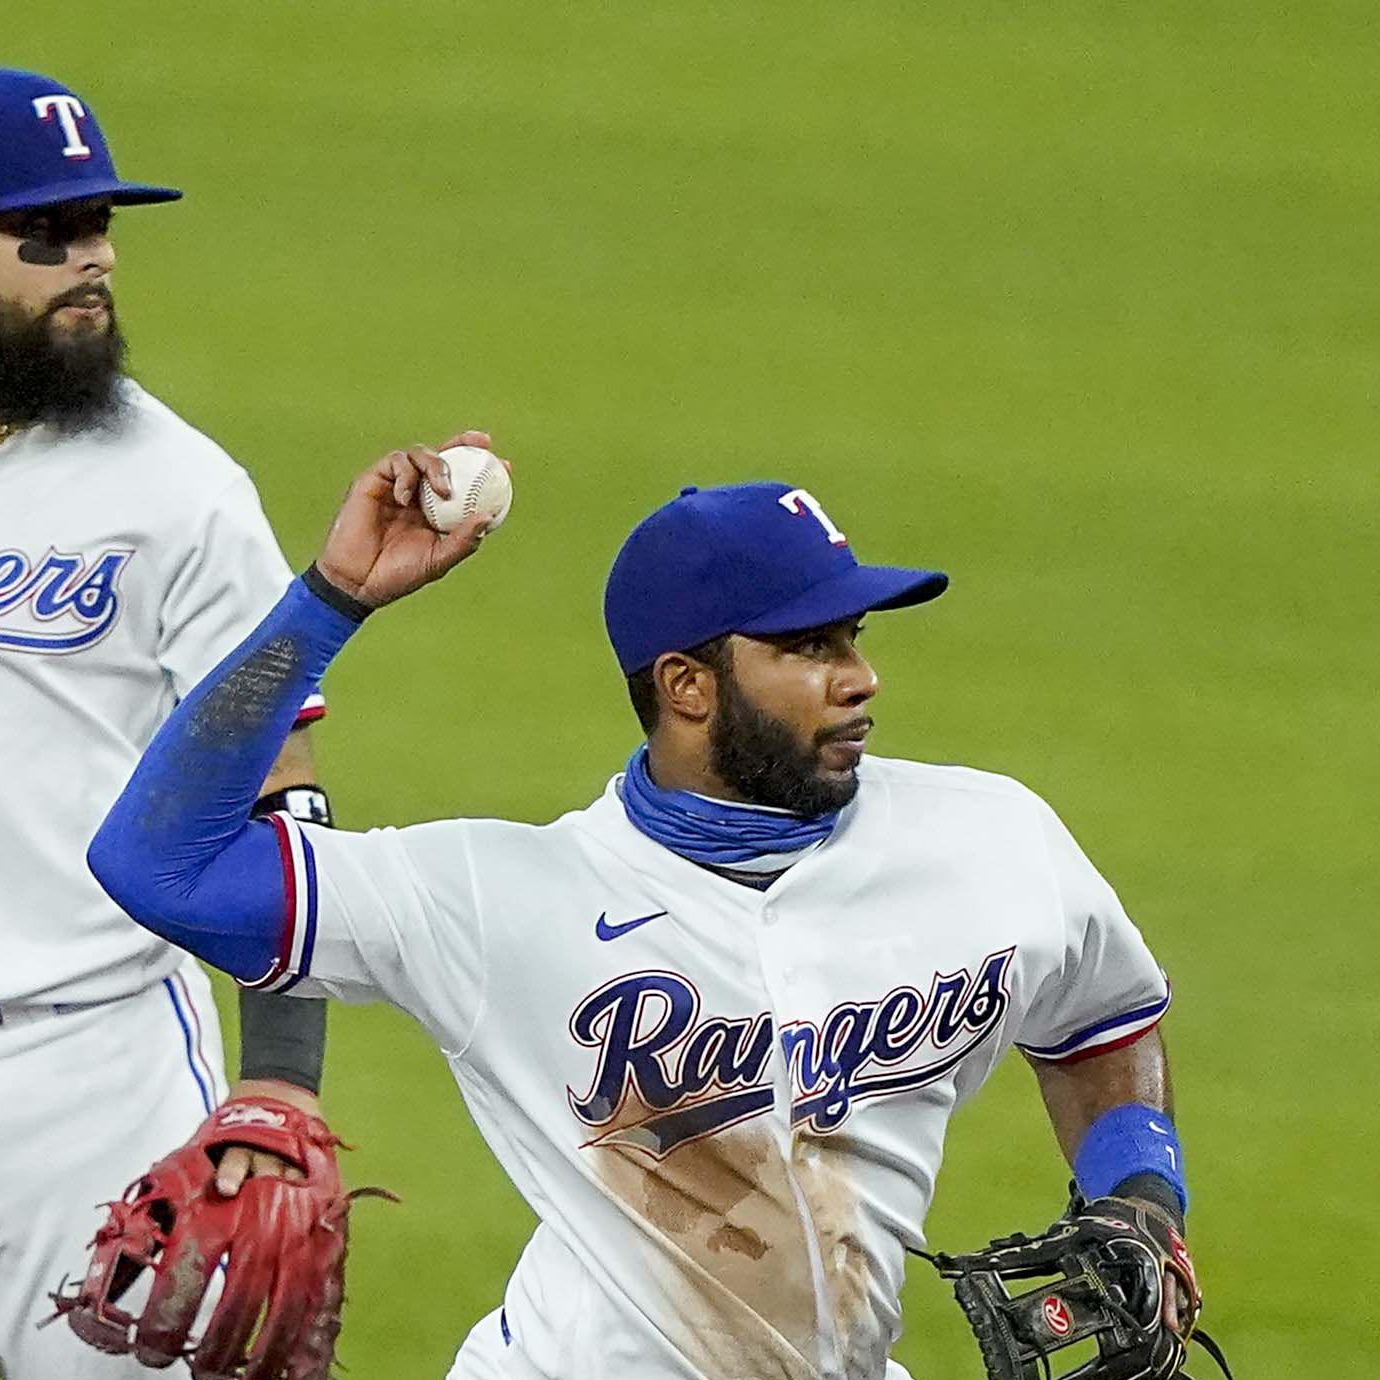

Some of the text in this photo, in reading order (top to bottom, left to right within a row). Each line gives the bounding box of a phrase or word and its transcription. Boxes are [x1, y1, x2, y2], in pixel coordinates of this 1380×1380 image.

[31, 94, 92, 160] T
[778, 489, 848, 547] T
[566, 944, 1017, 1160] Rangers
